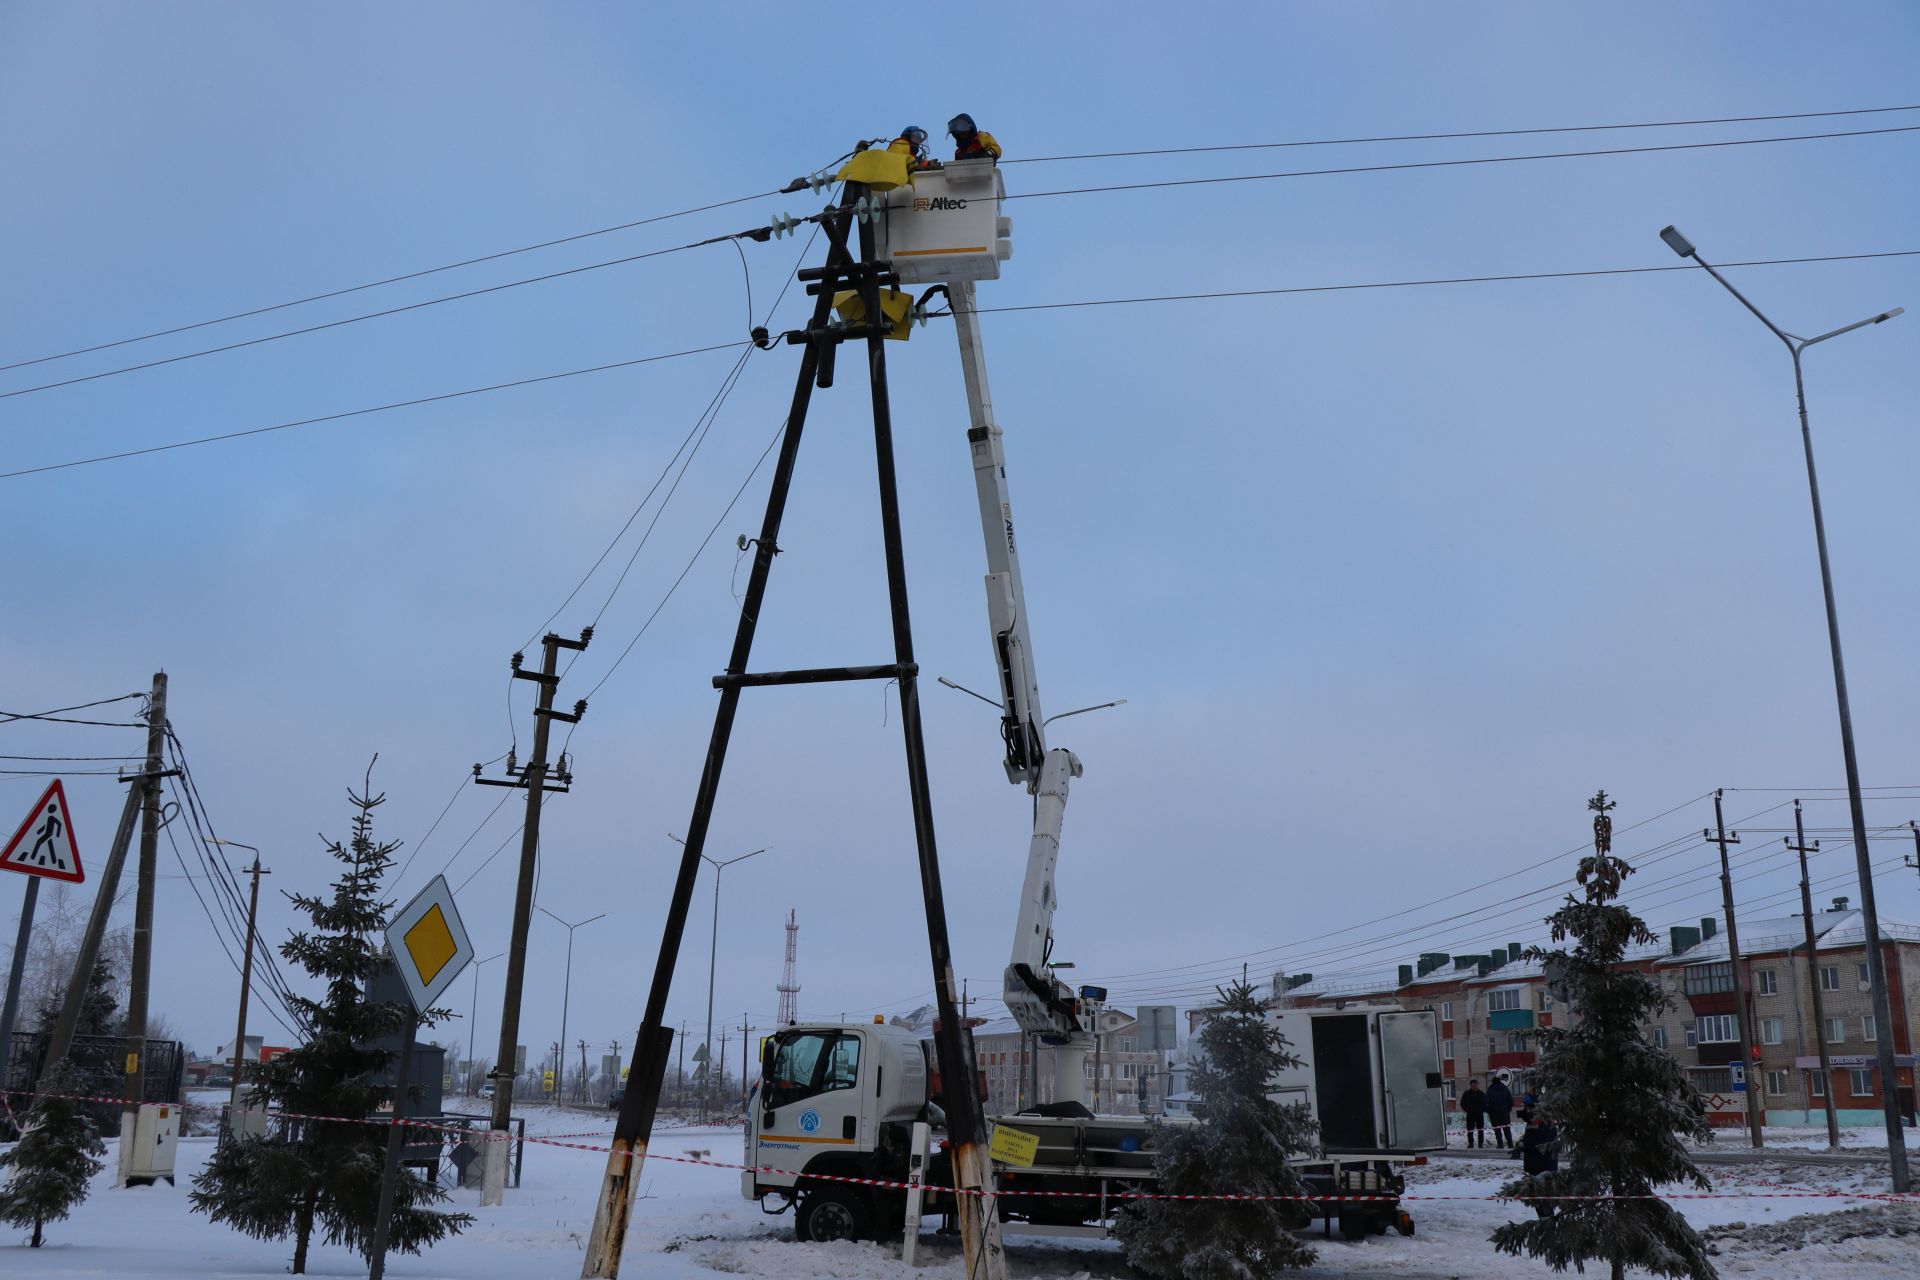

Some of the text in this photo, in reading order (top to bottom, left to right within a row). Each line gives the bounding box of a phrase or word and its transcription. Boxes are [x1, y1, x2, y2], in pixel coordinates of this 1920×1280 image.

[929, 197, 967, 211] Altec
[1005, 518, 1015, 555] Altec
[758, 1140, 800, 1151] ЭНЕРГОТРАНС
